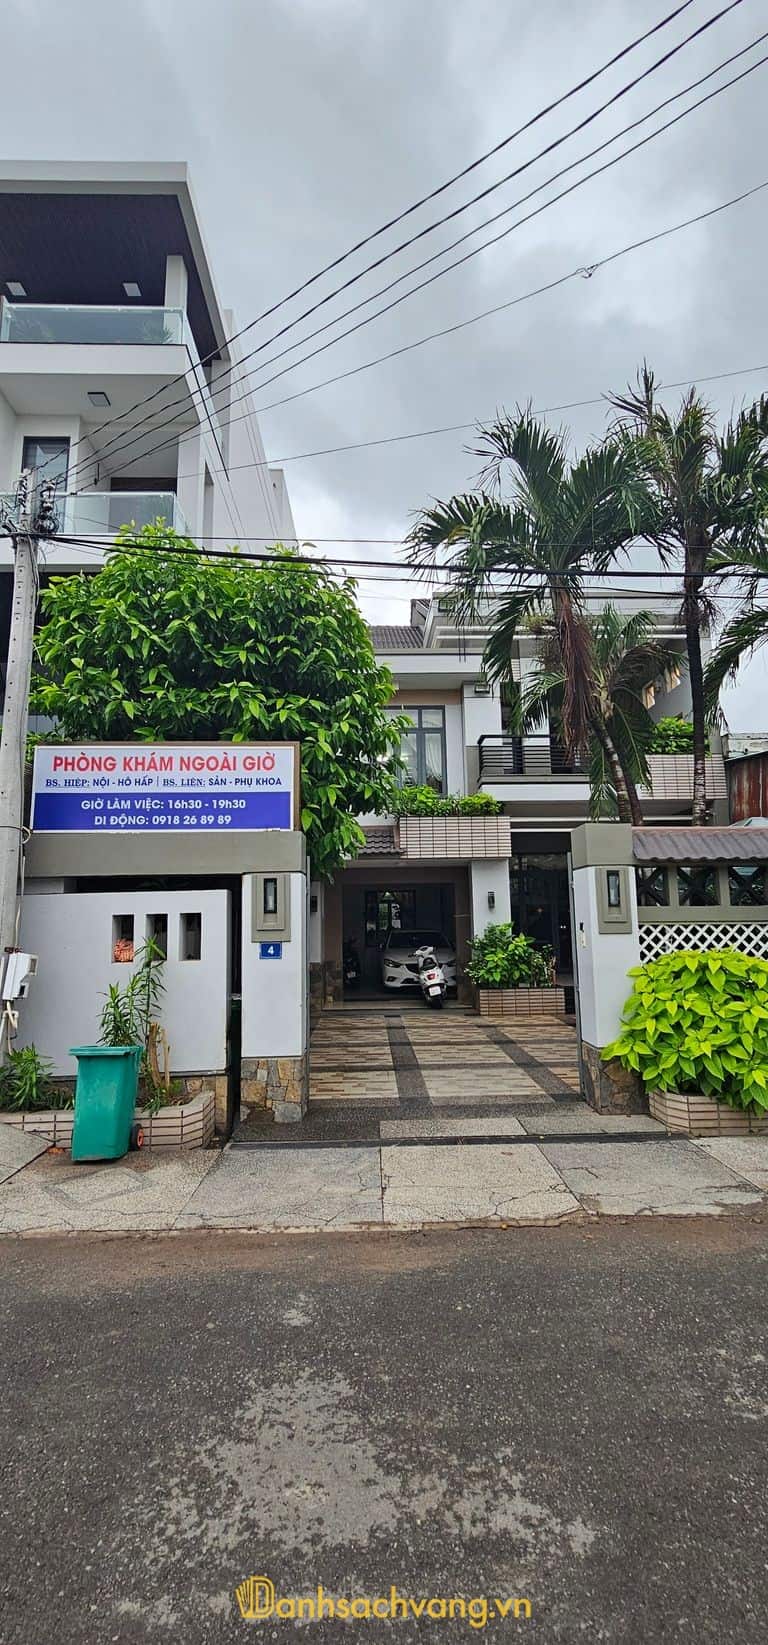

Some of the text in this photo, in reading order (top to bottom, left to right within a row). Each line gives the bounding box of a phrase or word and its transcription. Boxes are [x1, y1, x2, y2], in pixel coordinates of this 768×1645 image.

[53, 752, 275, 772] PHÒNG KHÁM NGOÀI GIỜ
[46, 778, 61, 787] BS.
[93, 776, 110, 788] NỘI
[135, 775, 153, 786] HẤP
[209, 775, 227, 786] SẢN
[235, 778, 253, 788] PHỤ
[256, 777, 282, 785] KHOA
[81, 798, 104, 810] GIỜ
[107, 798, 131, 809] LÀM
[135, 798, 164, 811] VIỆC:
[168, 800, 201, 809] 16h30
[212, 800, 246, 809] 19h30
[94, 813, 232, 827] DI ĐỘNG: 0918 26 89 89
[267, 945, 275, 955] 4
